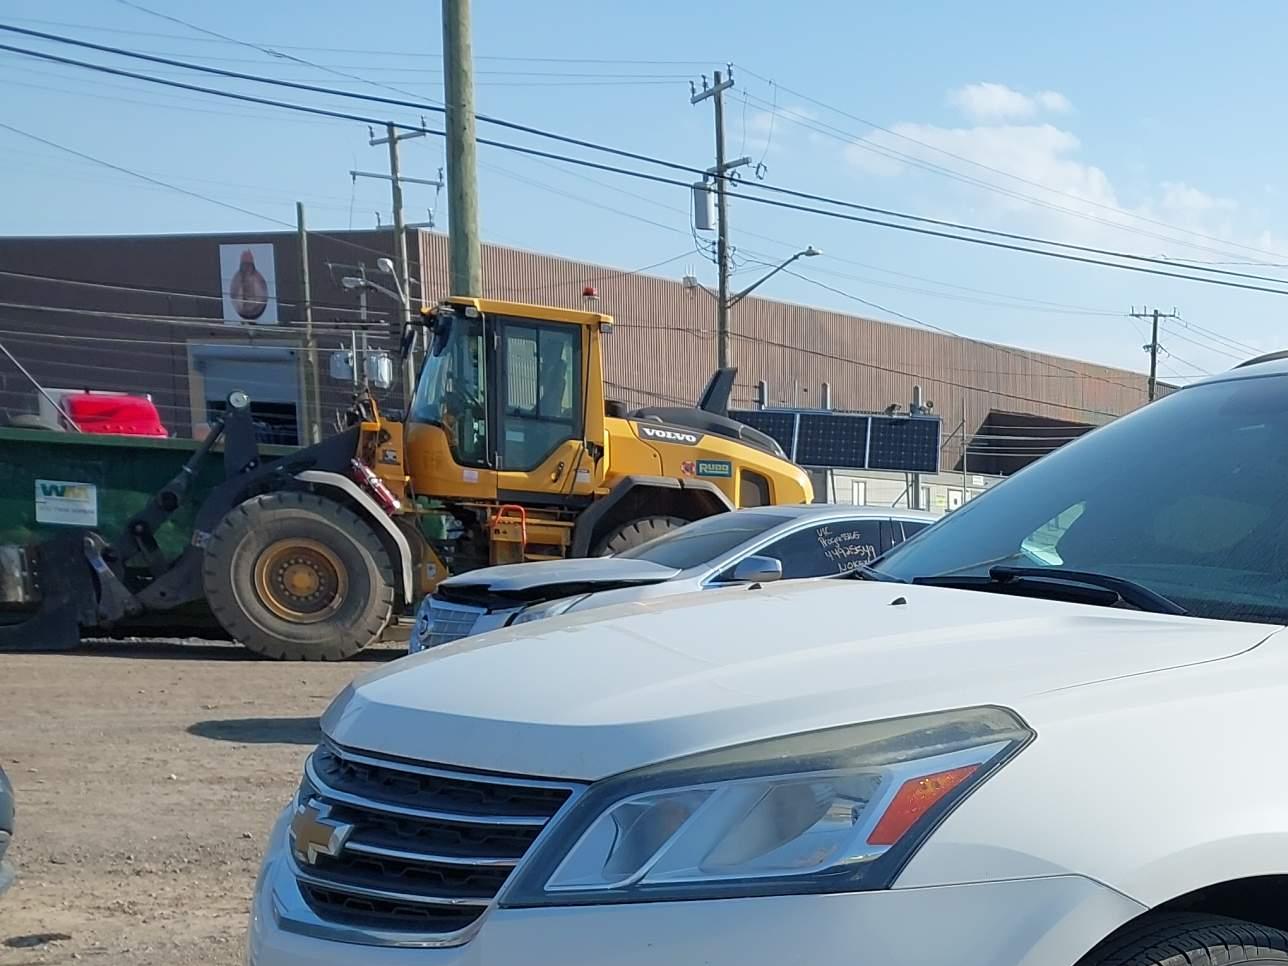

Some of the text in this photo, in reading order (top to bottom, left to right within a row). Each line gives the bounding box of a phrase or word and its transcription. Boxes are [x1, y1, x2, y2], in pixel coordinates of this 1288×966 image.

[642, 428, 697, 442] VOLVO
[699, 463, 729, 473] RUDD
[40, 484, 88, 499] WM
